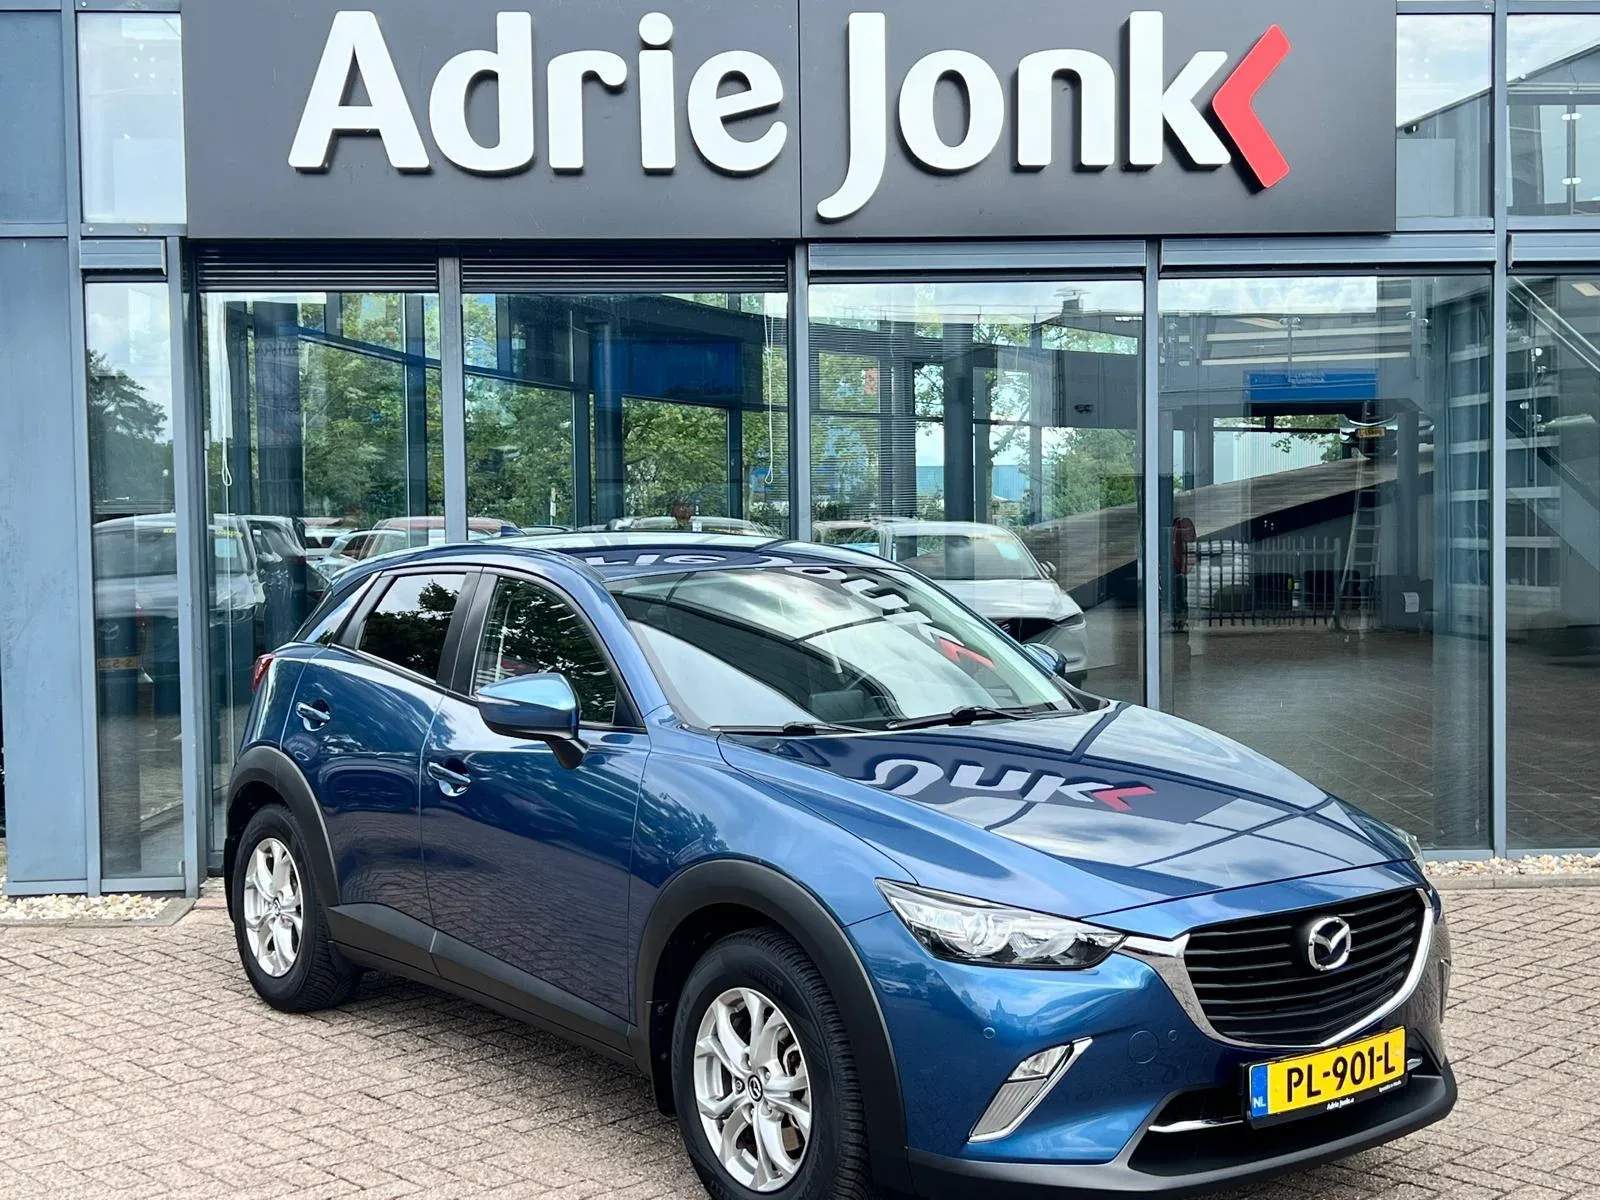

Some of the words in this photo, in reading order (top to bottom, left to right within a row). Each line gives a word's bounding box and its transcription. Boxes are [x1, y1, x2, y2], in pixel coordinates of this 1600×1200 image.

[288, 11, 788, 171] Adrie
[816, 11, 1231, 219] Jonk
[1253, 1097, 1266, 1108] NL
[1287, 1041, 1395, 1103] PL-901-L
